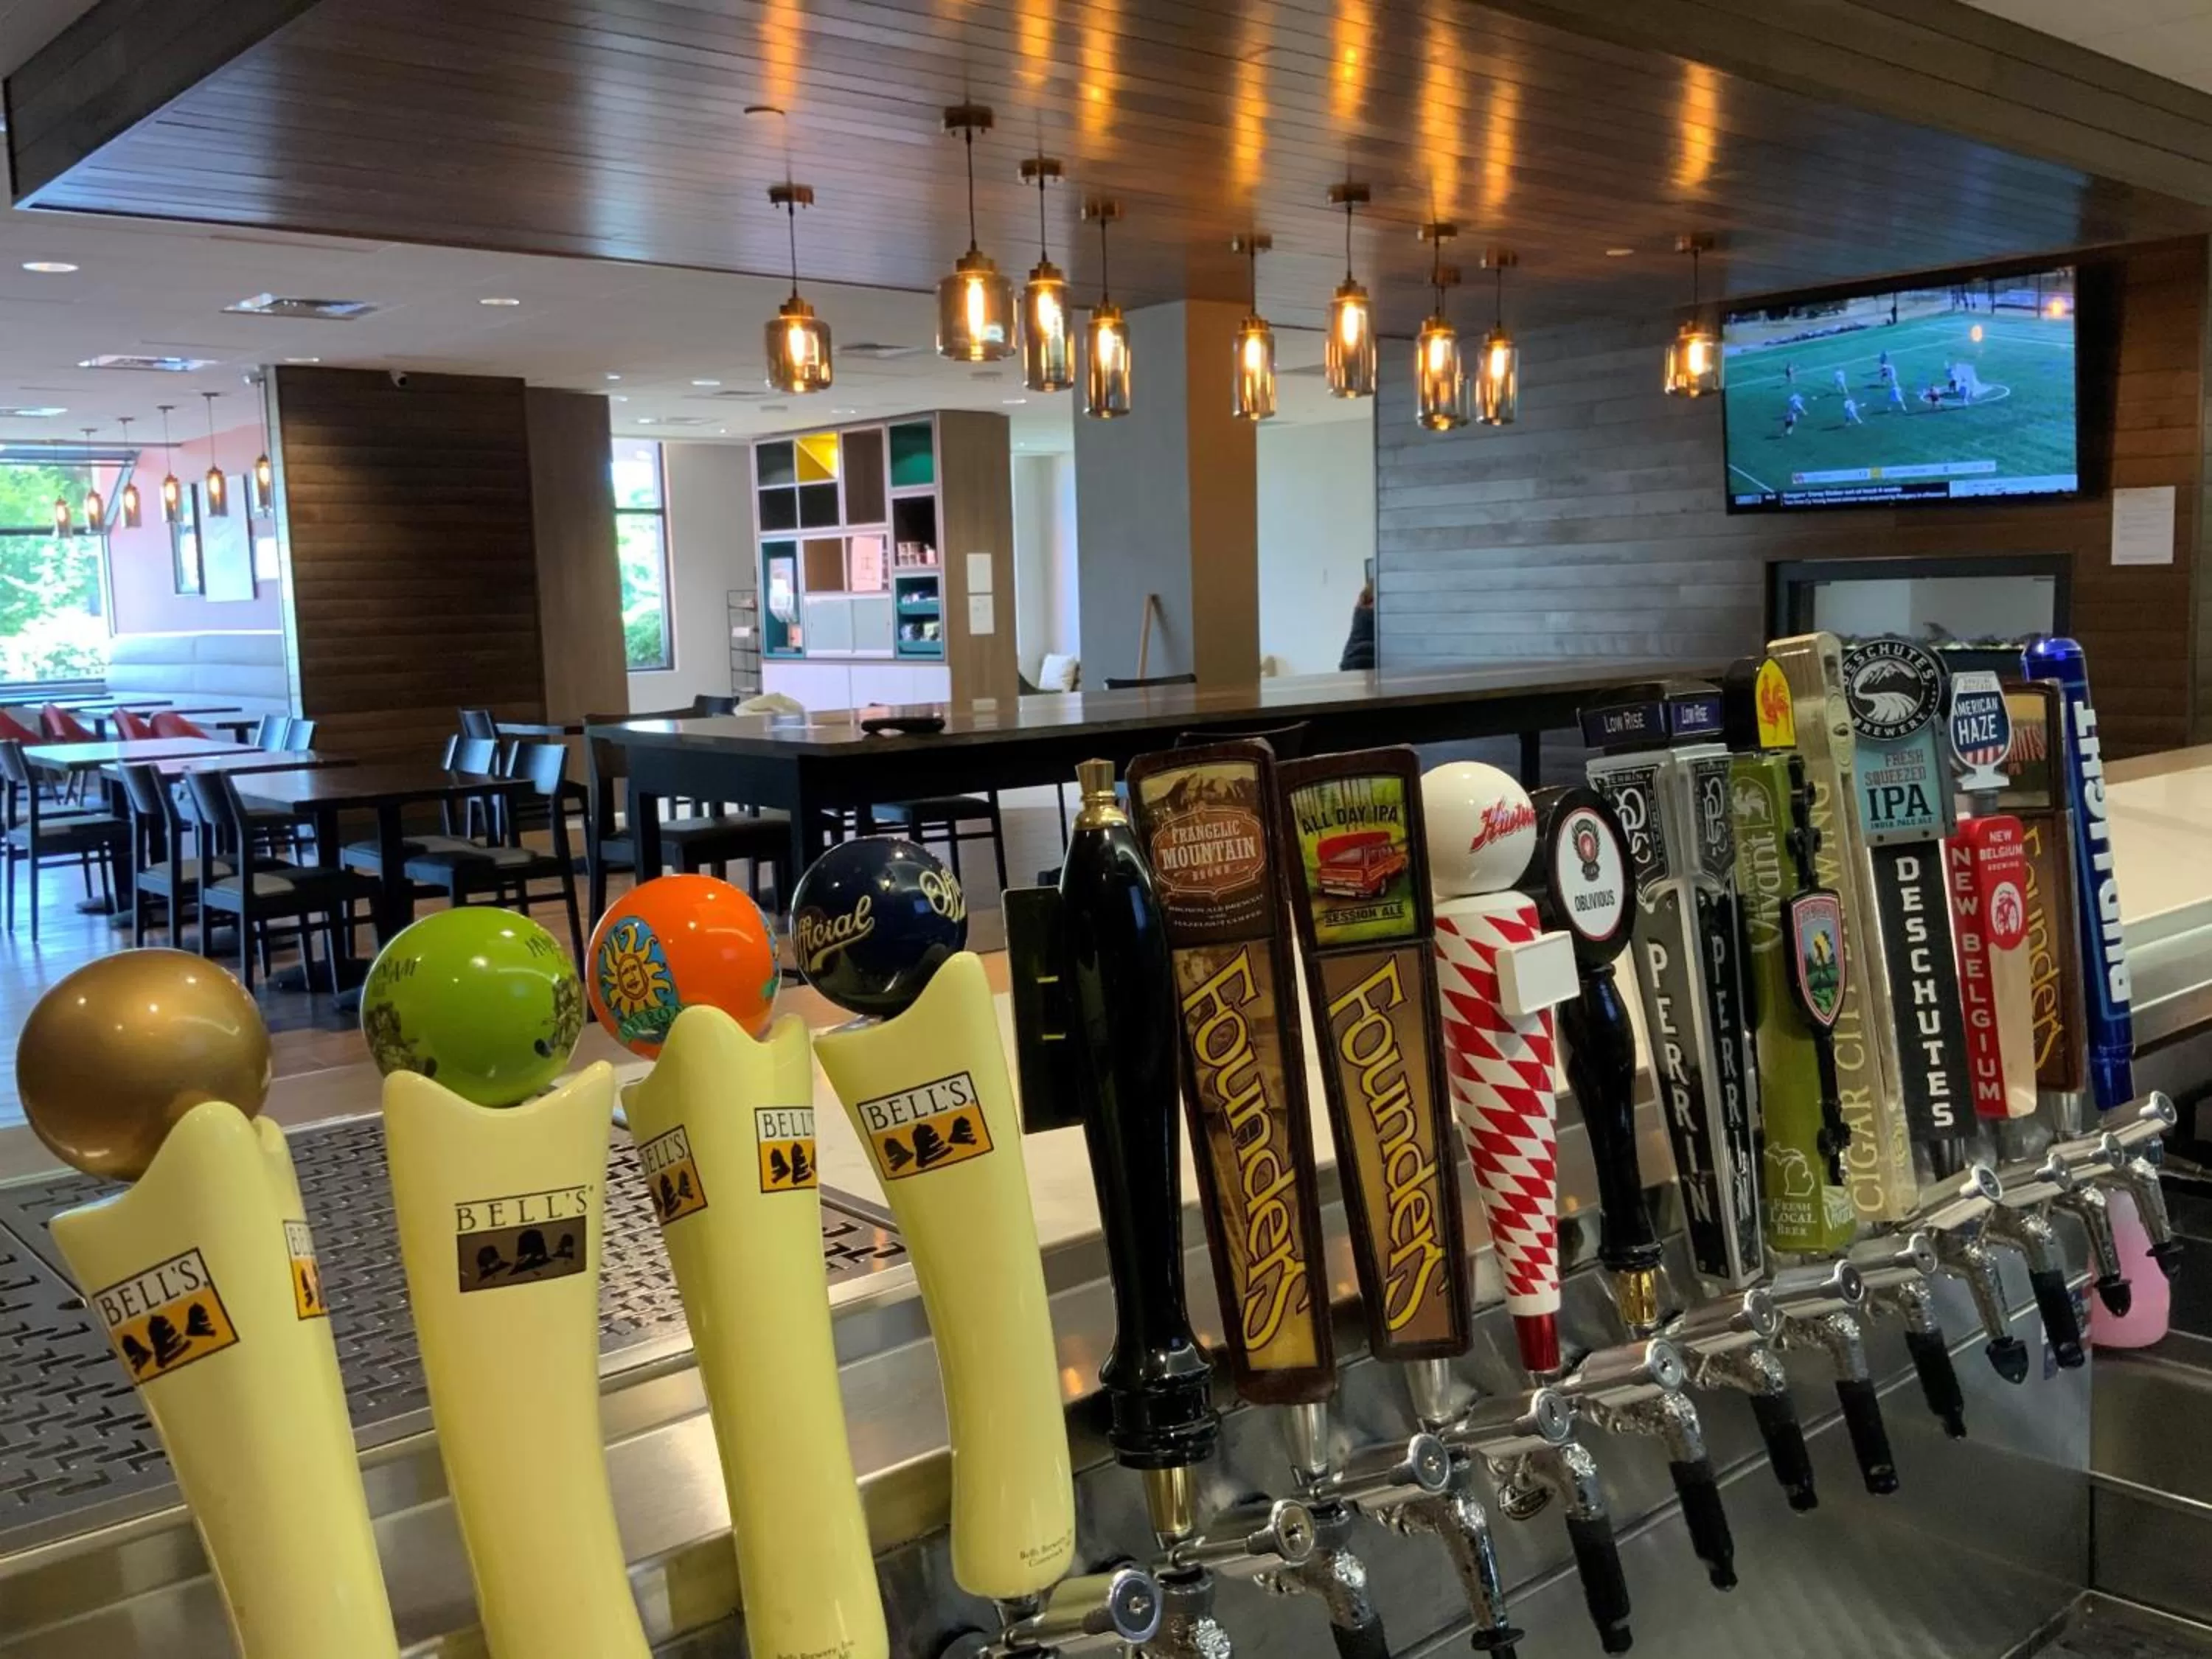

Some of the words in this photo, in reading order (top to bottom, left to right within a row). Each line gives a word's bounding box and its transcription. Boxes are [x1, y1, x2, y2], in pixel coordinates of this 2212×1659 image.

[1958, 713, 1998, 746] HAZE
[1885, 748, 1924, 768] FRESH
[1864, 766, 1927, 787] SQUEEZED
[1301, 812, 1334, 835] ALL
[1335, 805, 1366, 826] DAY
[1373, 805, 1398, 823] IPA
[1866, 783, 1933, 821] IPA
[1171, 819, 1241, 844] FRANGELIC
[1989, 829, 2012, 843] NEW
[1161, 836, 1256, 871] MOUNTAIN
[1979, 843, 2023, 861] BELGIUM
[1574, 888, 1615, 912] OBLIVIOUS
[1895, 857, 1954, 1128] DESCHUTES
[1647, 942, 1712, 1224] PERRIN
[866, 1081, 969, 1131] BELL'S
[1181, 944, 1311, 1352] Founders
[1327, 953, 1448, 1331] Founders
[1840, 1085, 1885, 1213] CIGAR
[456, 1192, 590, 1232] BELL'S
[99, 1260, 204, 1326] BELL'S
